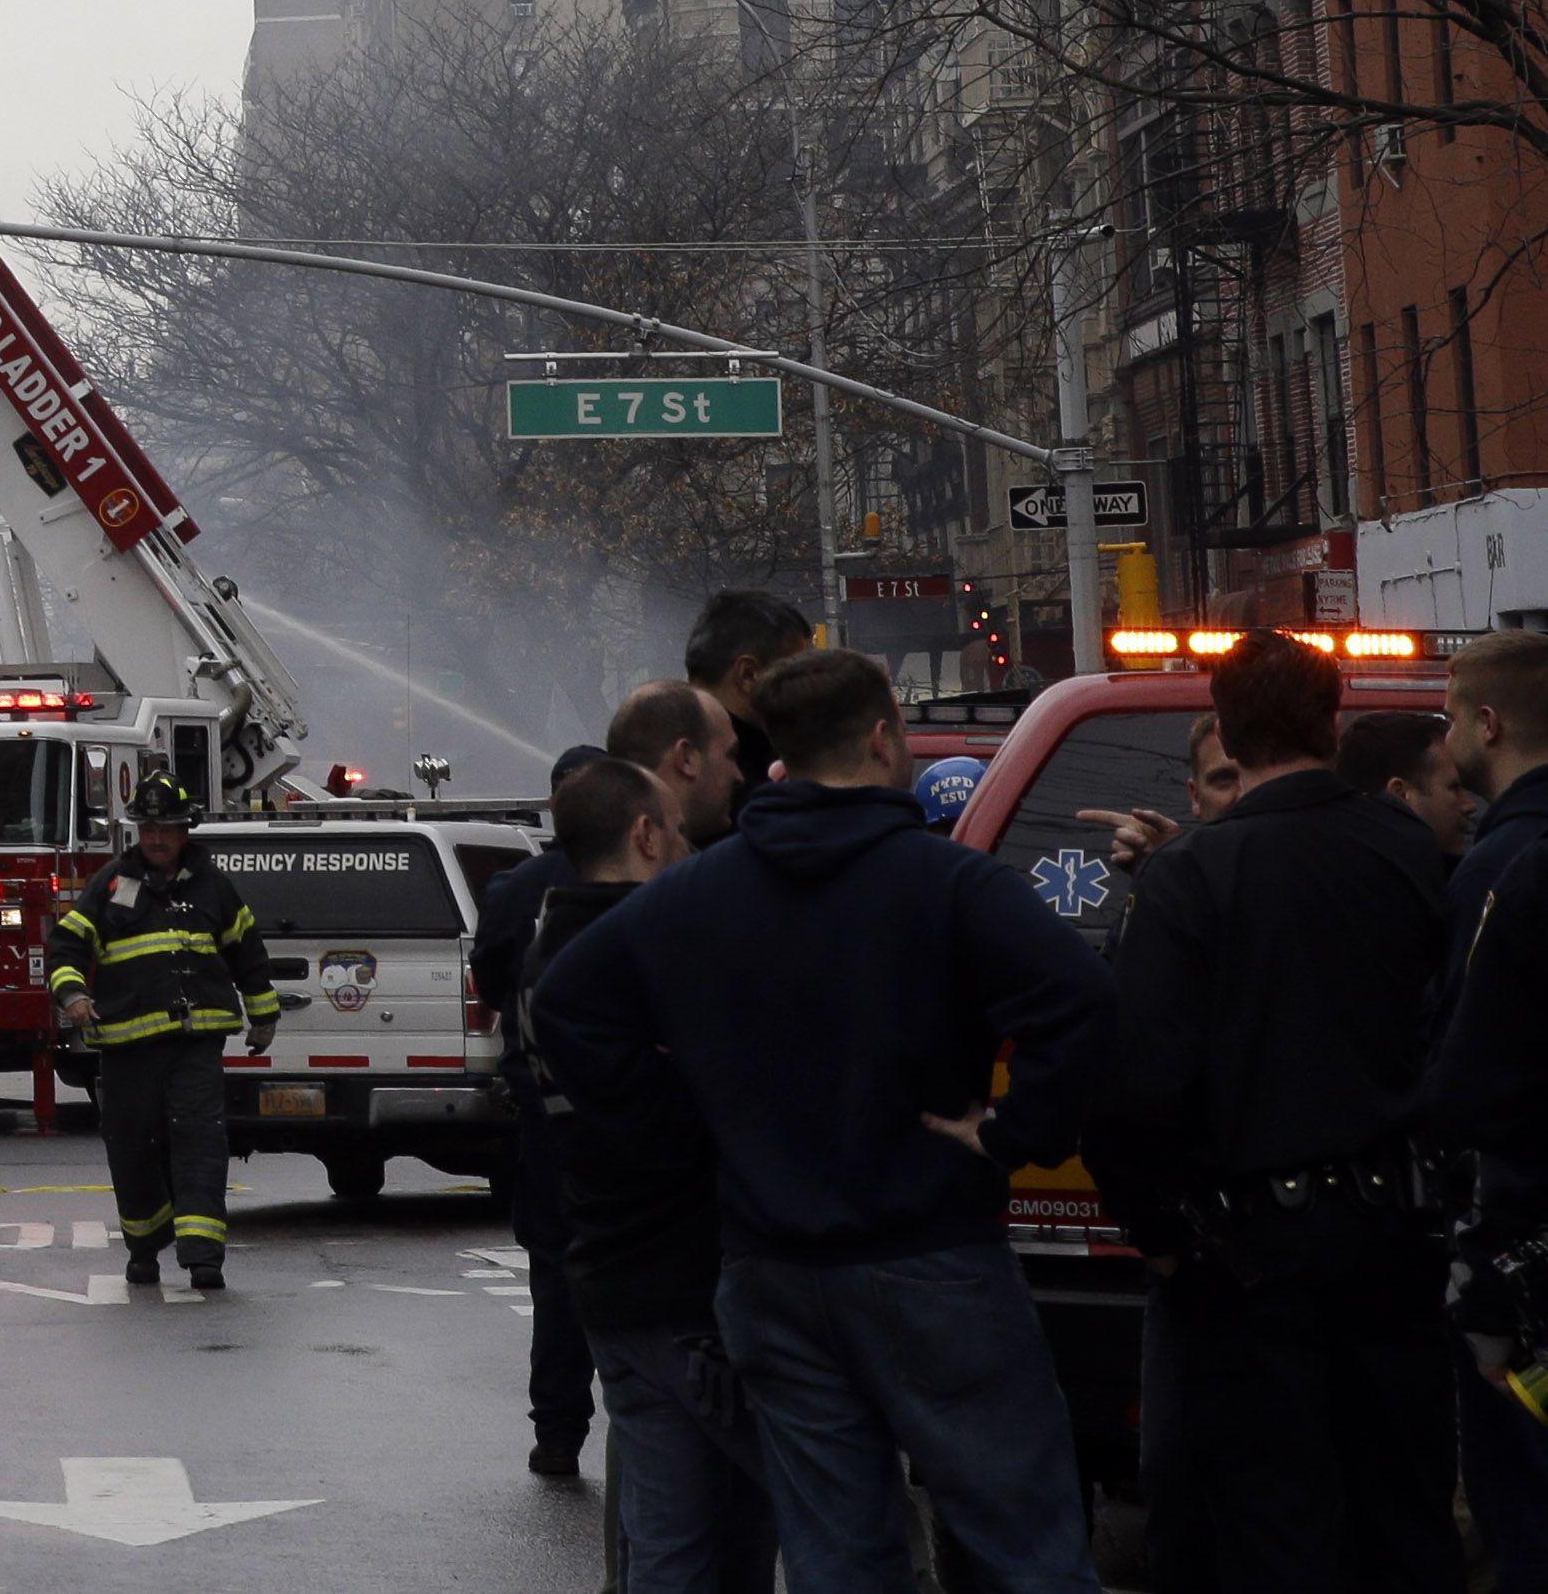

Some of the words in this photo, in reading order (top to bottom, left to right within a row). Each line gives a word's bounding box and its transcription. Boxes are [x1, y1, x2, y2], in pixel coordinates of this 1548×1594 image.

[577, 393, 602, 424] E
[617, 392, 644, 424] 7
[661, 392, 711, 424] St
[77, 457, 107, 483] 1
[1094, 496, 1133, 513] WAY
[877, 582, 885, 597] E
[891, 581, 899, 597] 7
[904, 581, 920, 597] St
[930, 776, 974, 797] NYPD
[940, 790, 967, 805] ESU
[211, 853, 297, 872] RGENCY
[302, 852, 410, 872] RESPONSE
[1008, 1199, 1101, 1218] GM09031
